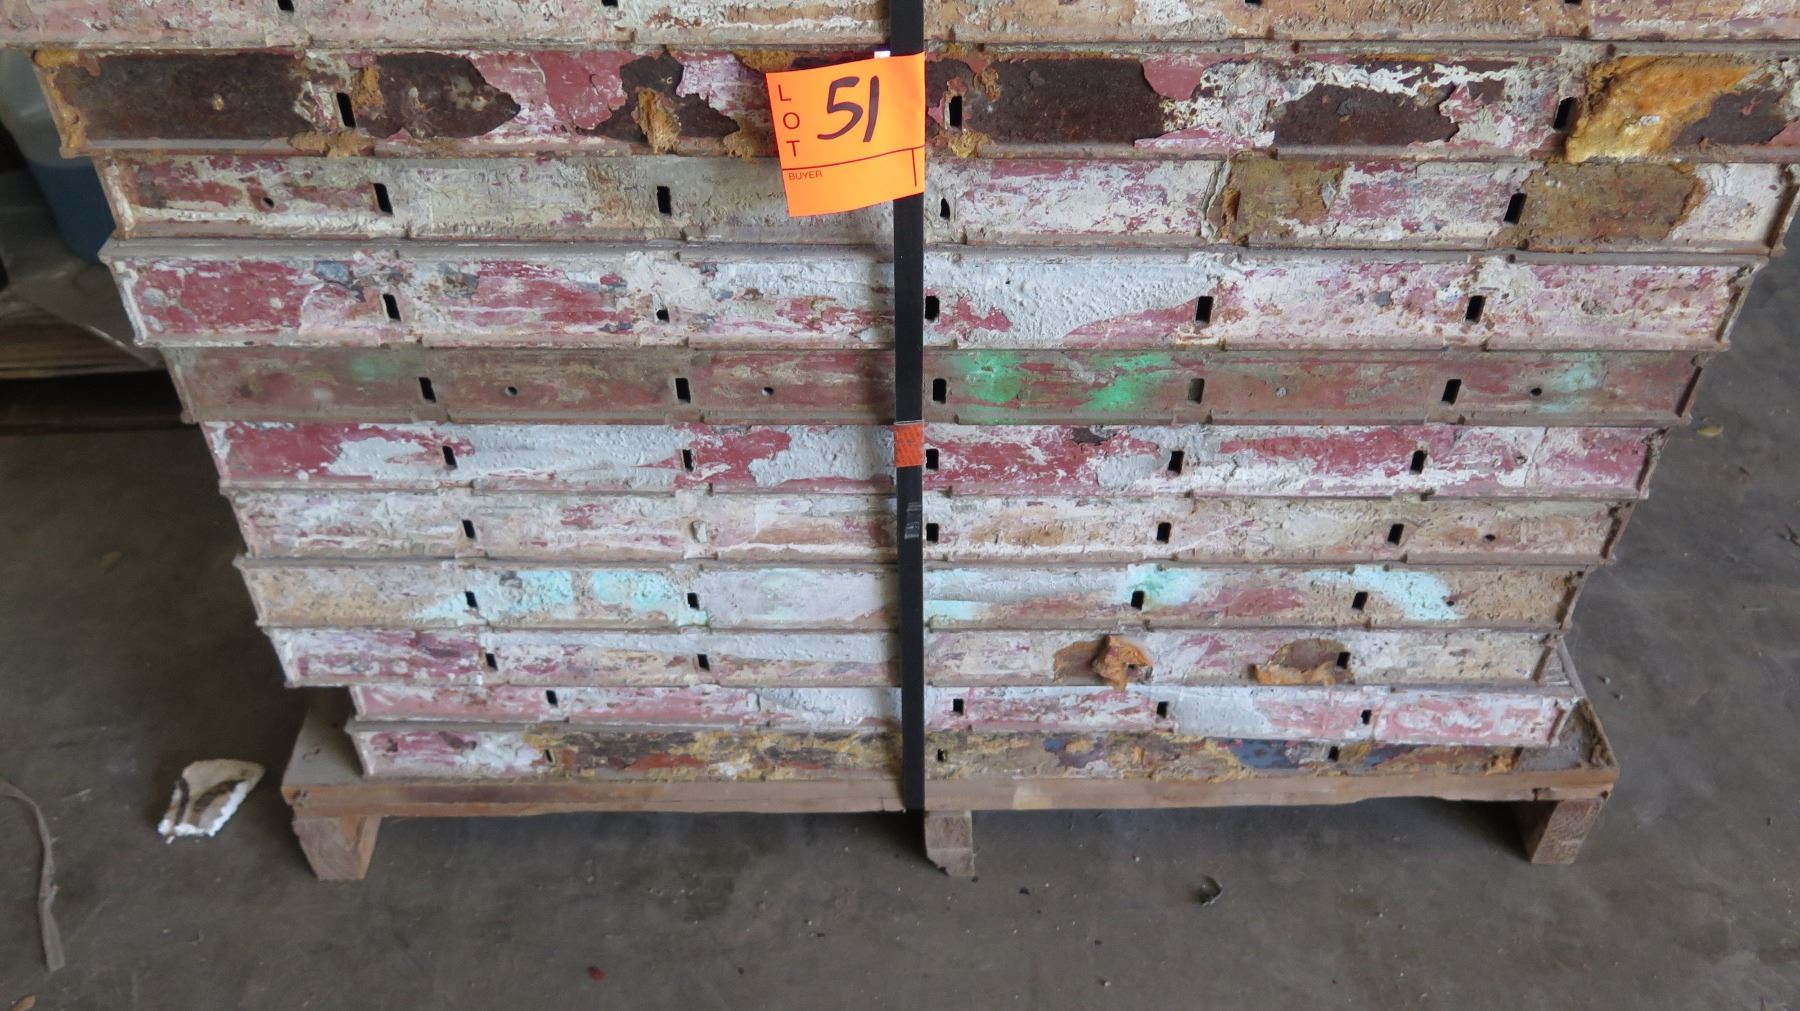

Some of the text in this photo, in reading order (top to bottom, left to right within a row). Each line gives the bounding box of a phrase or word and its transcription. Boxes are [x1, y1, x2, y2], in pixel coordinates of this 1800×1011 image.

[778, 84, 800, 157] LOT
[817, 75, 880, 143] 51
[788, 170, 823, 180] BUYER
